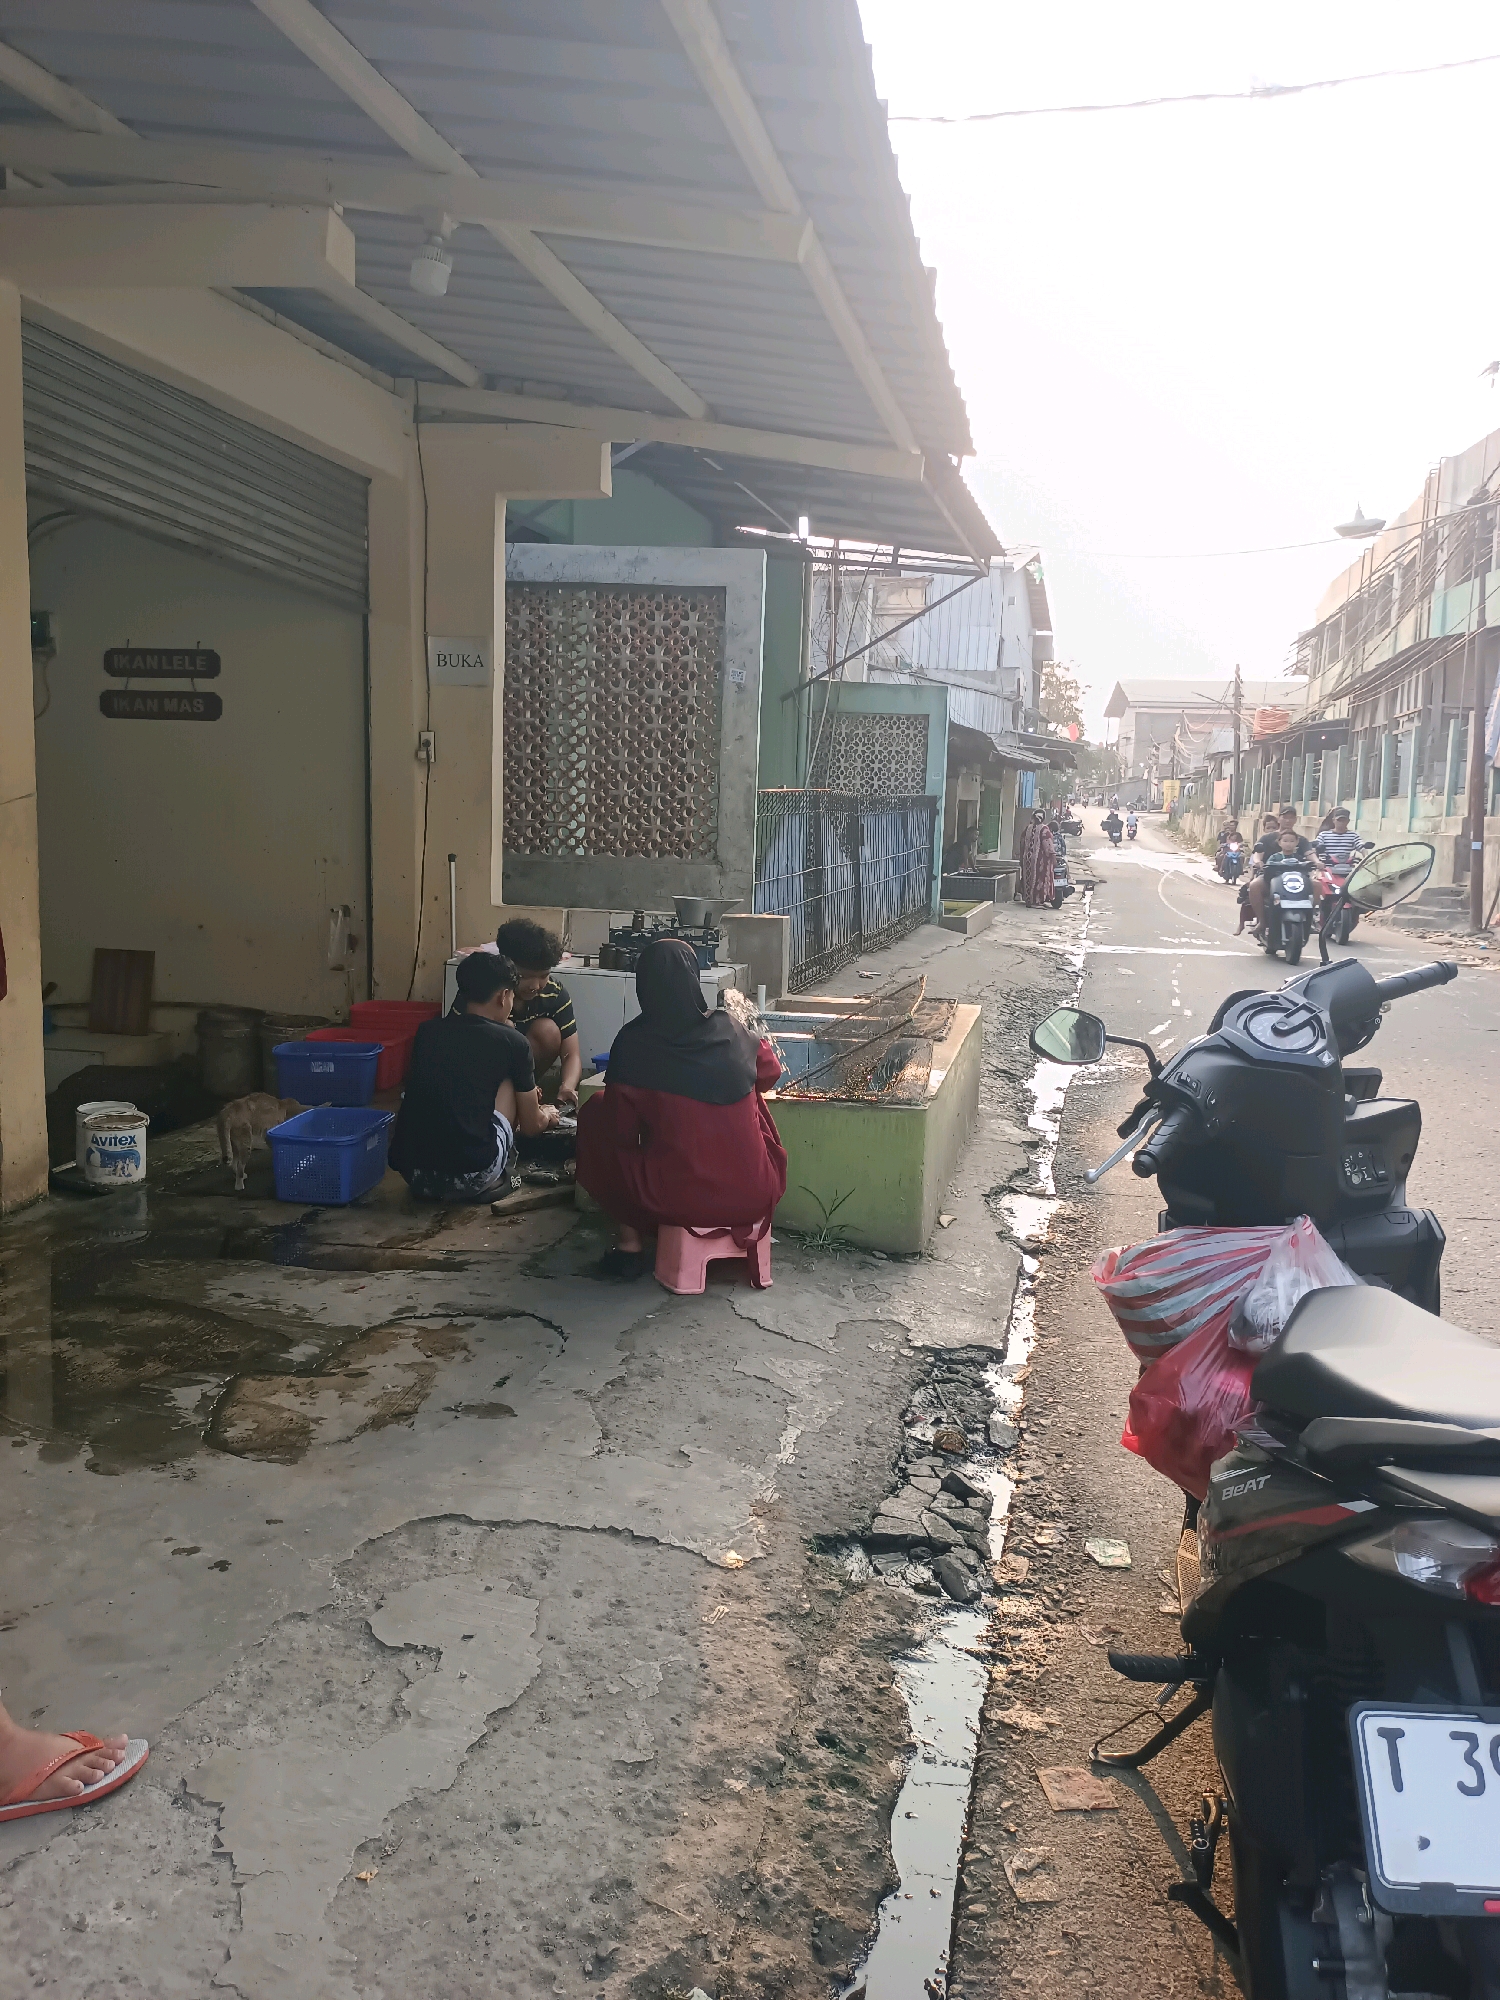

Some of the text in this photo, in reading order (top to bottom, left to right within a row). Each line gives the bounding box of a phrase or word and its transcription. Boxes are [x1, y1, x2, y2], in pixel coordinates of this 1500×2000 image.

[113, 654, 207, 671] IKAN LELE
[436, 653, 484, 668] BUKA
[113, 697, 204, 713] IKAN MAS
[91, 1134, 137, 1147] Avitex
[1376, 1727, 1405, 1793] T
